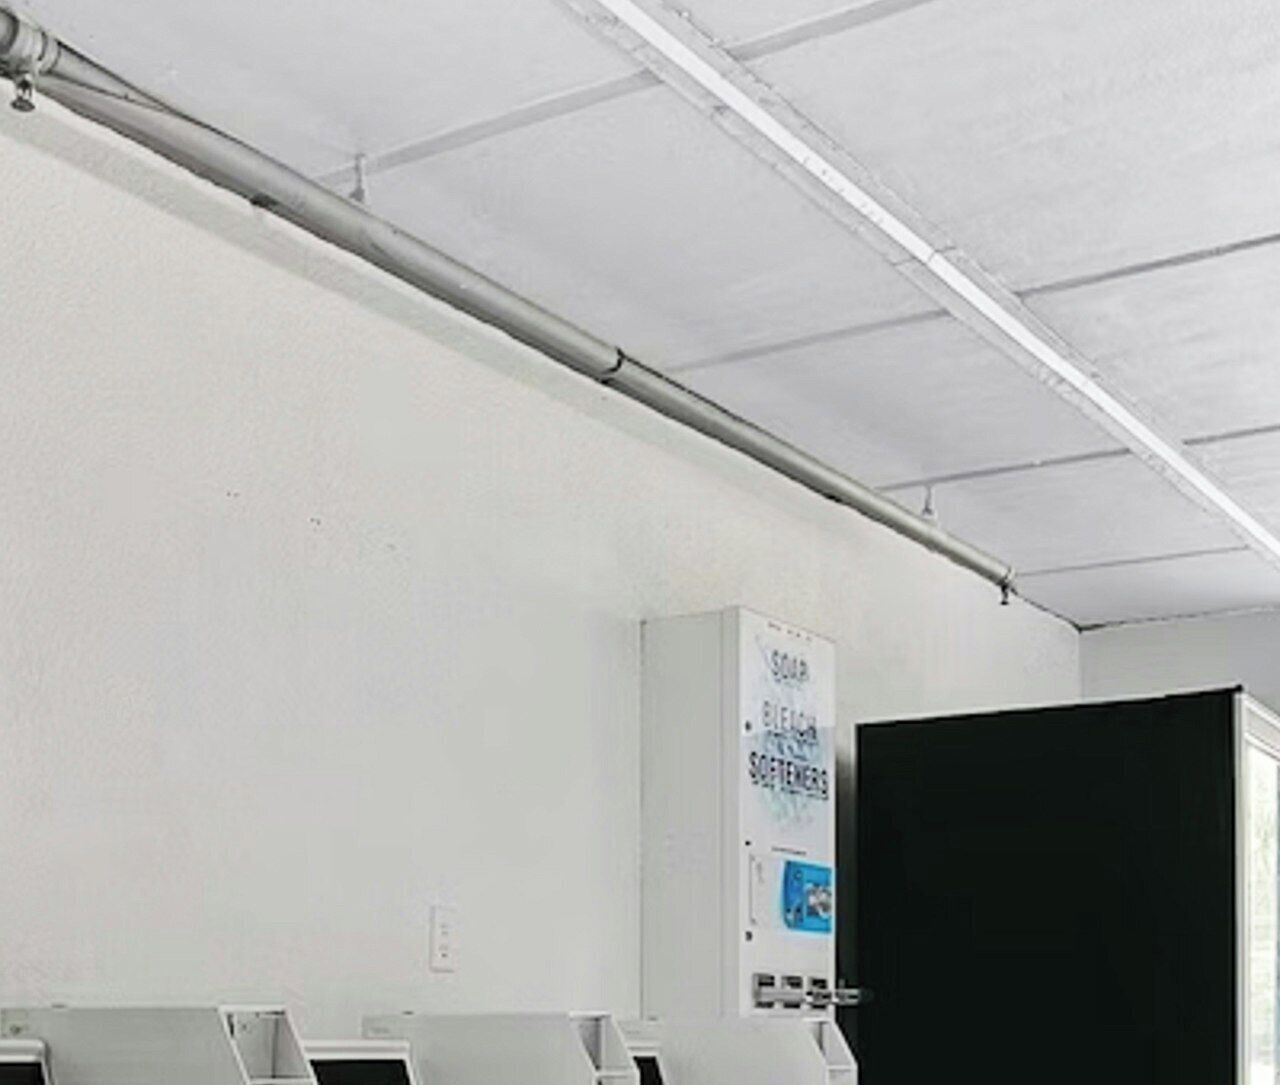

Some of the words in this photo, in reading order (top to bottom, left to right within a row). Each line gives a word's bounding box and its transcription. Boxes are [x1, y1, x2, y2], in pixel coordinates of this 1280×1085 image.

[771, 649, 810, 682] SOAP
[763, 700, 817, 741] BLEACH
[749, 751, 828, 798] SOFTENERS
